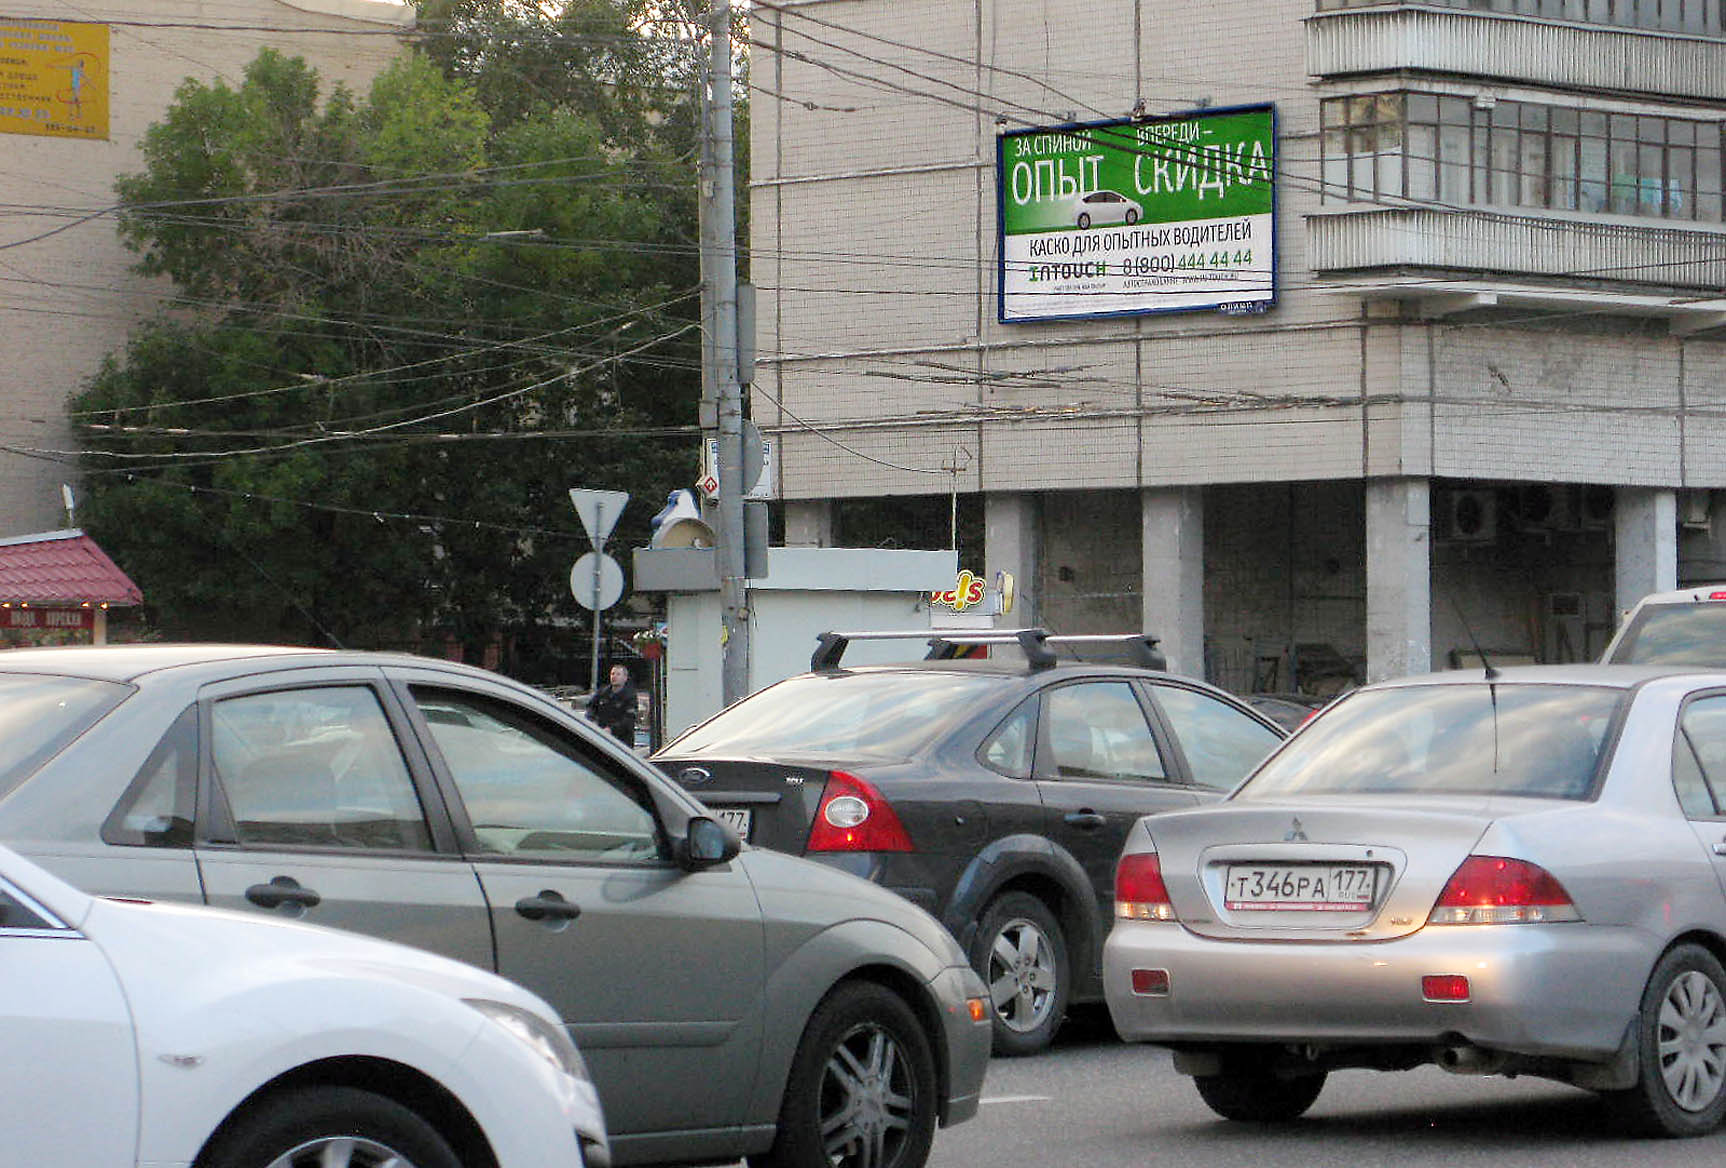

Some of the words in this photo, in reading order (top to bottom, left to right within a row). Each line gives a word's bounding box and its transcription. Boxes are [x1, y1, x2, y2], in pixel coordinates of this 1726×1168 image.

[1014, 136, 1031, 157] ЗА
[1034, 129, 1092, 155] СПИНОЙ
[1136, 121, 1200, 147] ВПЕРЕДИ
[1012, 155, 1104, 205] ОПЫТ
[1134, 141, 1268, 200] СКИДКА
[1029, 236, 1070, 257] КАСКО
[1072, 234, 1100, 257] ДЛЯ
[1104, 228, 1170, 252] ОПЫТНЫХ
[1174, 217, 1252, 248] ВОДИТЕЛЕЙ
[1178, 252, 1205, 271] 444
[1209, 250, 1229, 268] 44
[1233, 247, 1252, 266] 44
[1237, 871, 1325, 898] Т346РА
[1334, 870, 1368, 890] 177
